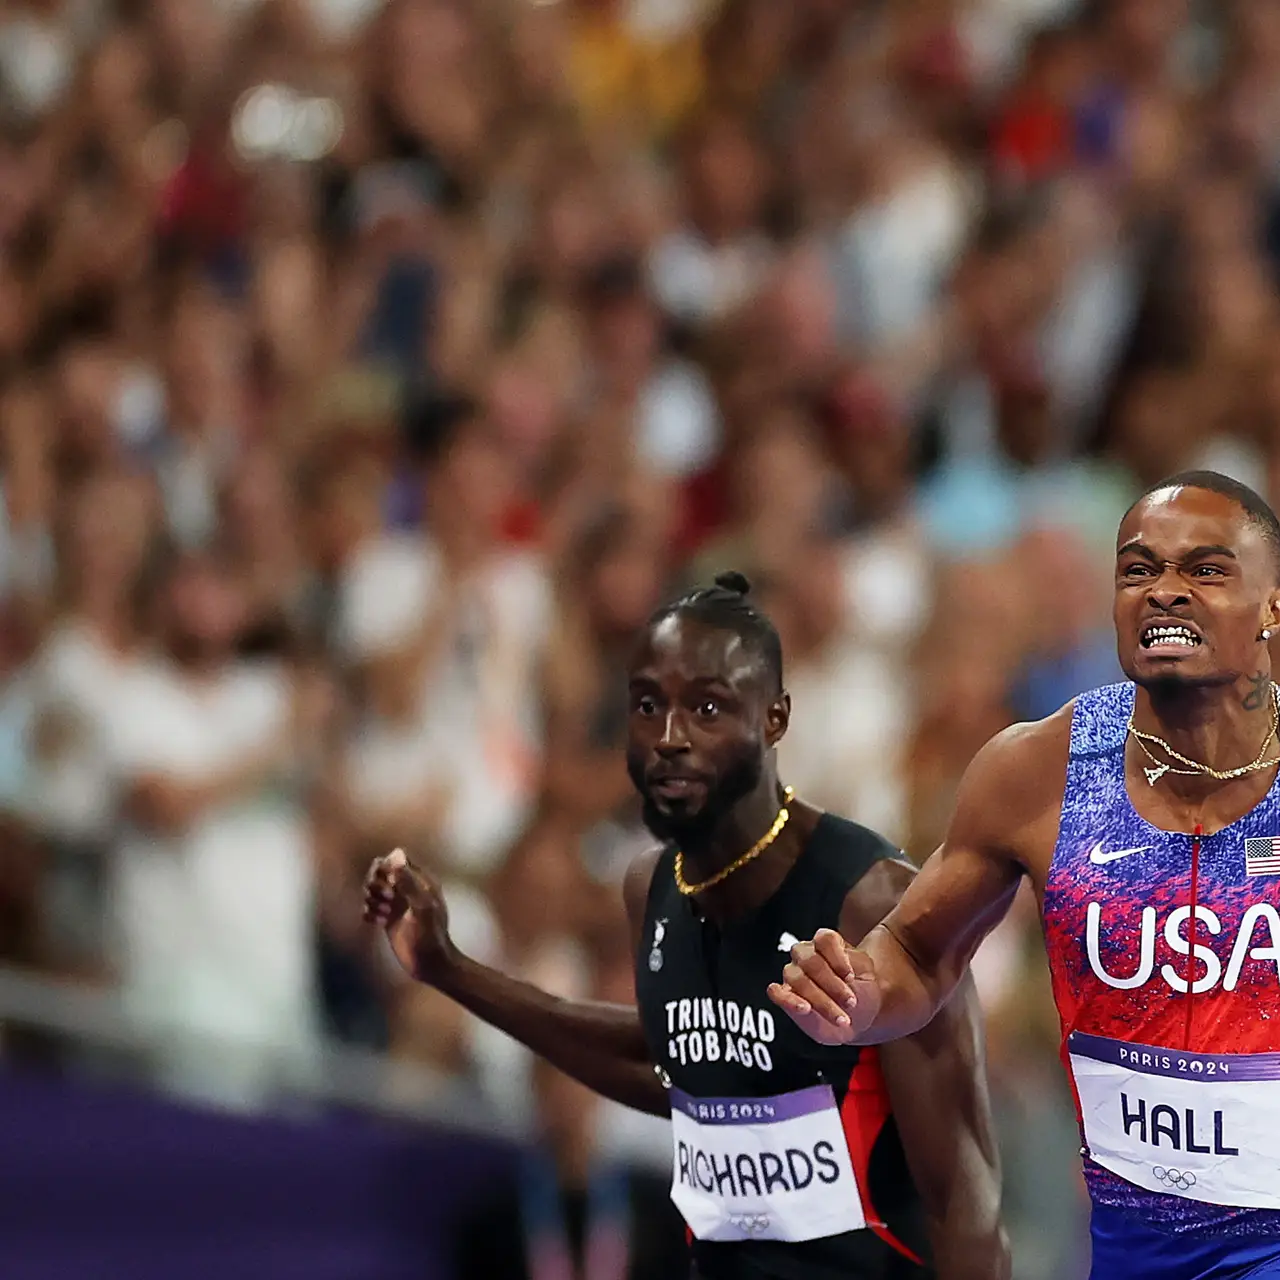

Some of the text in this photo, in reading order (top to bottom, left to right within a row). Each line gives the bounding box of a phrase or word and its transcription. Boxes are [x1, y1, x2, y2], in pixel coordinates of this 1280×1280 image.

[665, 997, 775, 1043] TRINIDAD
[1178, 1058, 1230, 1075] 2024
[729, 1103, 776, 1119] 2024
[1120, 1092, 1239, 1157] HALL
[678, 1140, 840, 1197] RICHARDS
